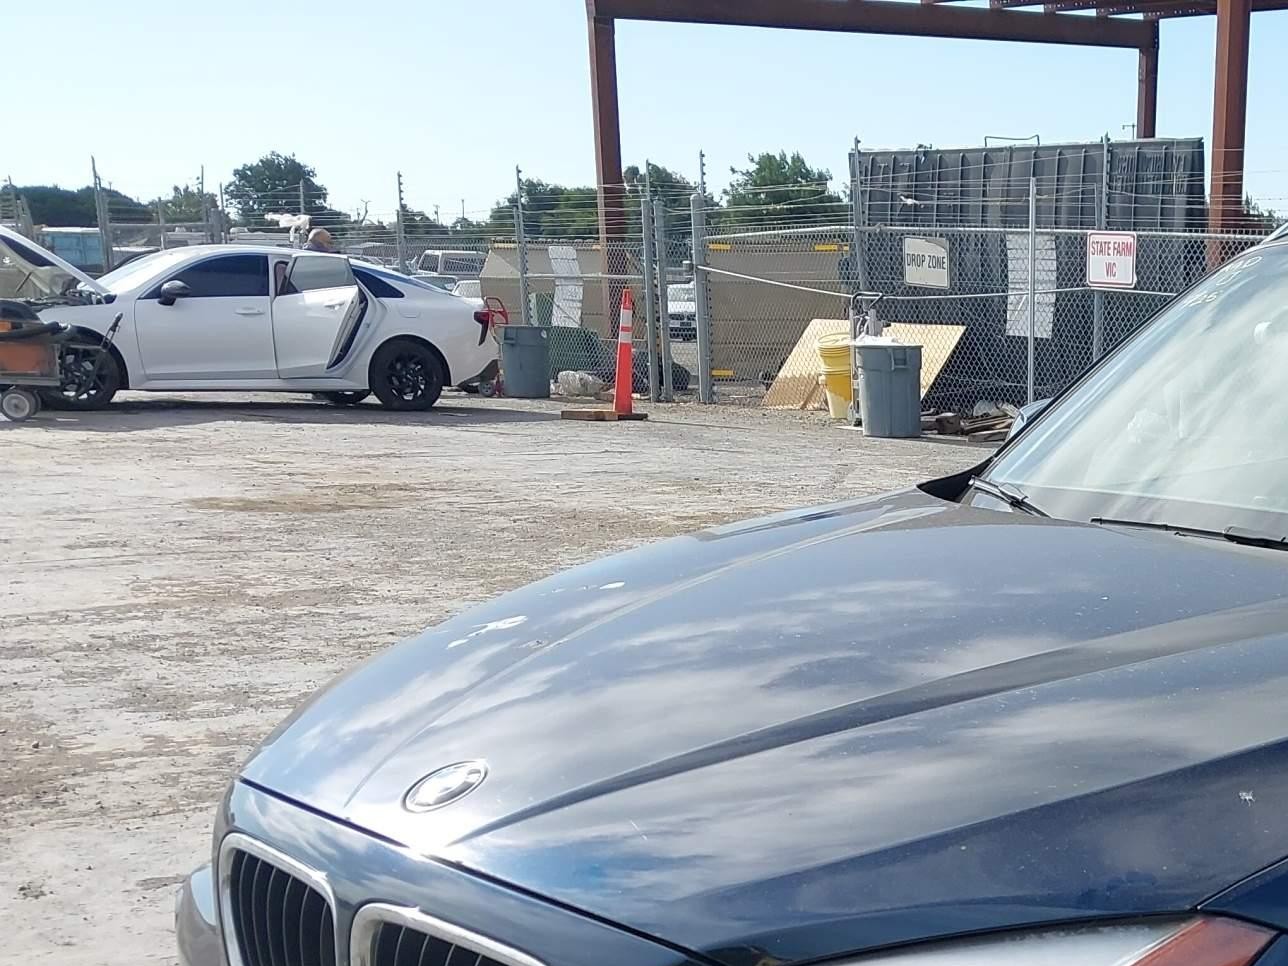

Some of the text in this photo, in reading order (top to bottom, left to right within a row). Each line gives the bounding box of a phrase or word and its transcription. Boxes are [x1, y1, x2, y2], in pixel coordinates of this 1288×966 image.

[1091, 240, 1132, 256] STATE FARM
[906, 253, 946, 270] DROP ZONE
[1105, 262, 1117, 277] VIC
